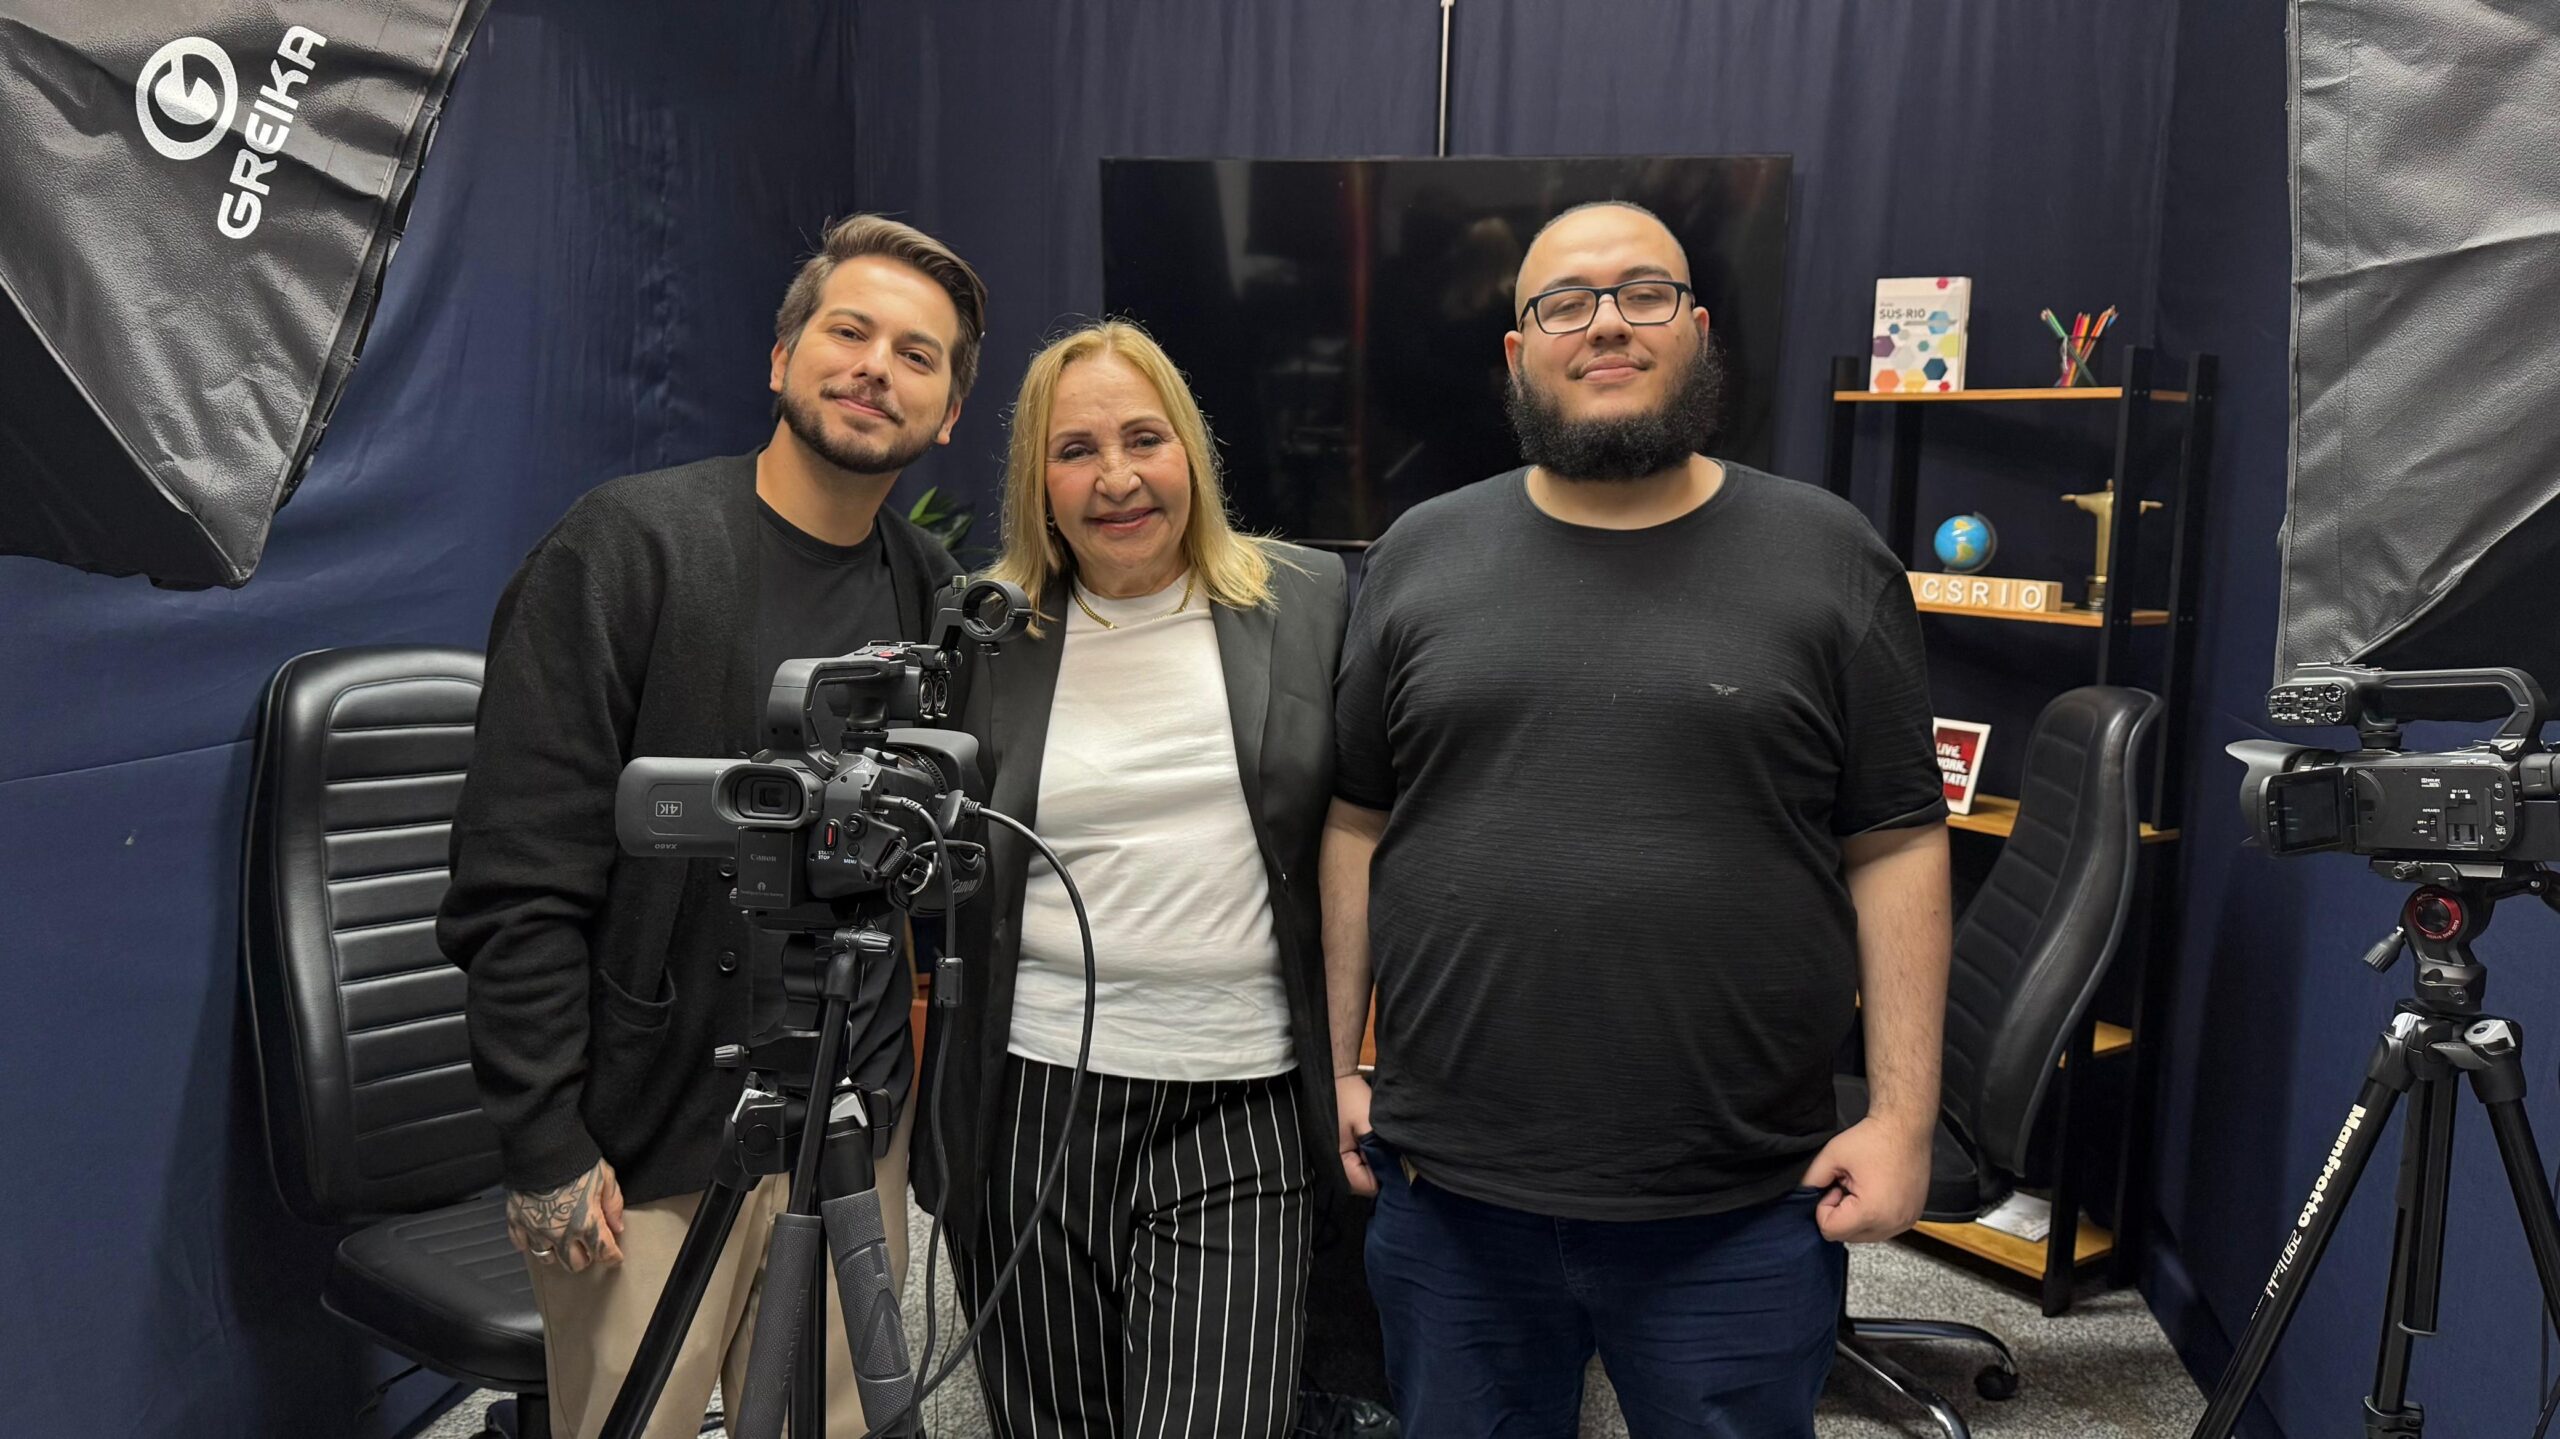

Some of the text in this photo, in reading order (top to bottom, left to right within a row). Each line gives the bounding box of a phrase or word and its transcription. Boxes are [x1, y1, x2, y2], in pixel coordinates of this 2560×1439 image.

[217, 25, 328, 240] GREIKA
[1922, 578, 2042, 610] CSRIO
[660, 803, 679, 814] 4K
[750, 854, 777, 862] Canon
[952, 879, 979, 894] Canon
[2298, 1104, 2367, 1228] Manfrotto
